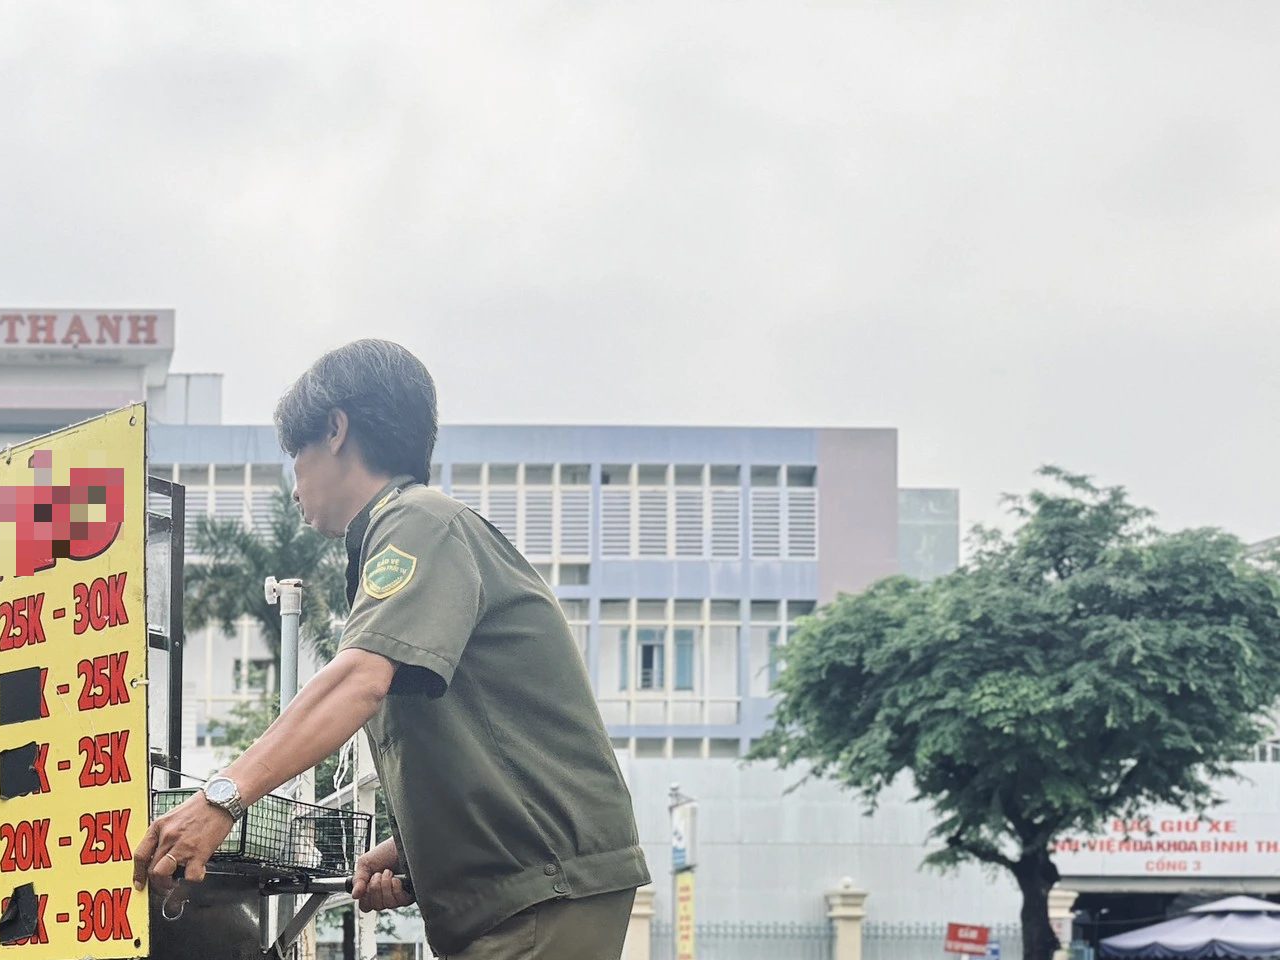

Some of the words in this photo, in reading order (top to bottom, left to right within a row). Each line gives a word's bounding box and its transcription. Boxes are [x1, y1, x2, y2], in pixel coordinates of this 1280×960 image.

[0, 314, 158, 349] THẠNH
[73, 571, 129, 635] 30K
[77, 651, 131, 711] 25K
[78, 730, 131, 788] 25K
[0, 818, 52, 872] 20K
[79, 808, 132, 865] 25K
[1200, 837, 1249, 853] BÌNH
[1208, 819, 1237, 833] XE
[1192, 861, 1202, 871] 3
[77, 887, 134, 942] 30K
